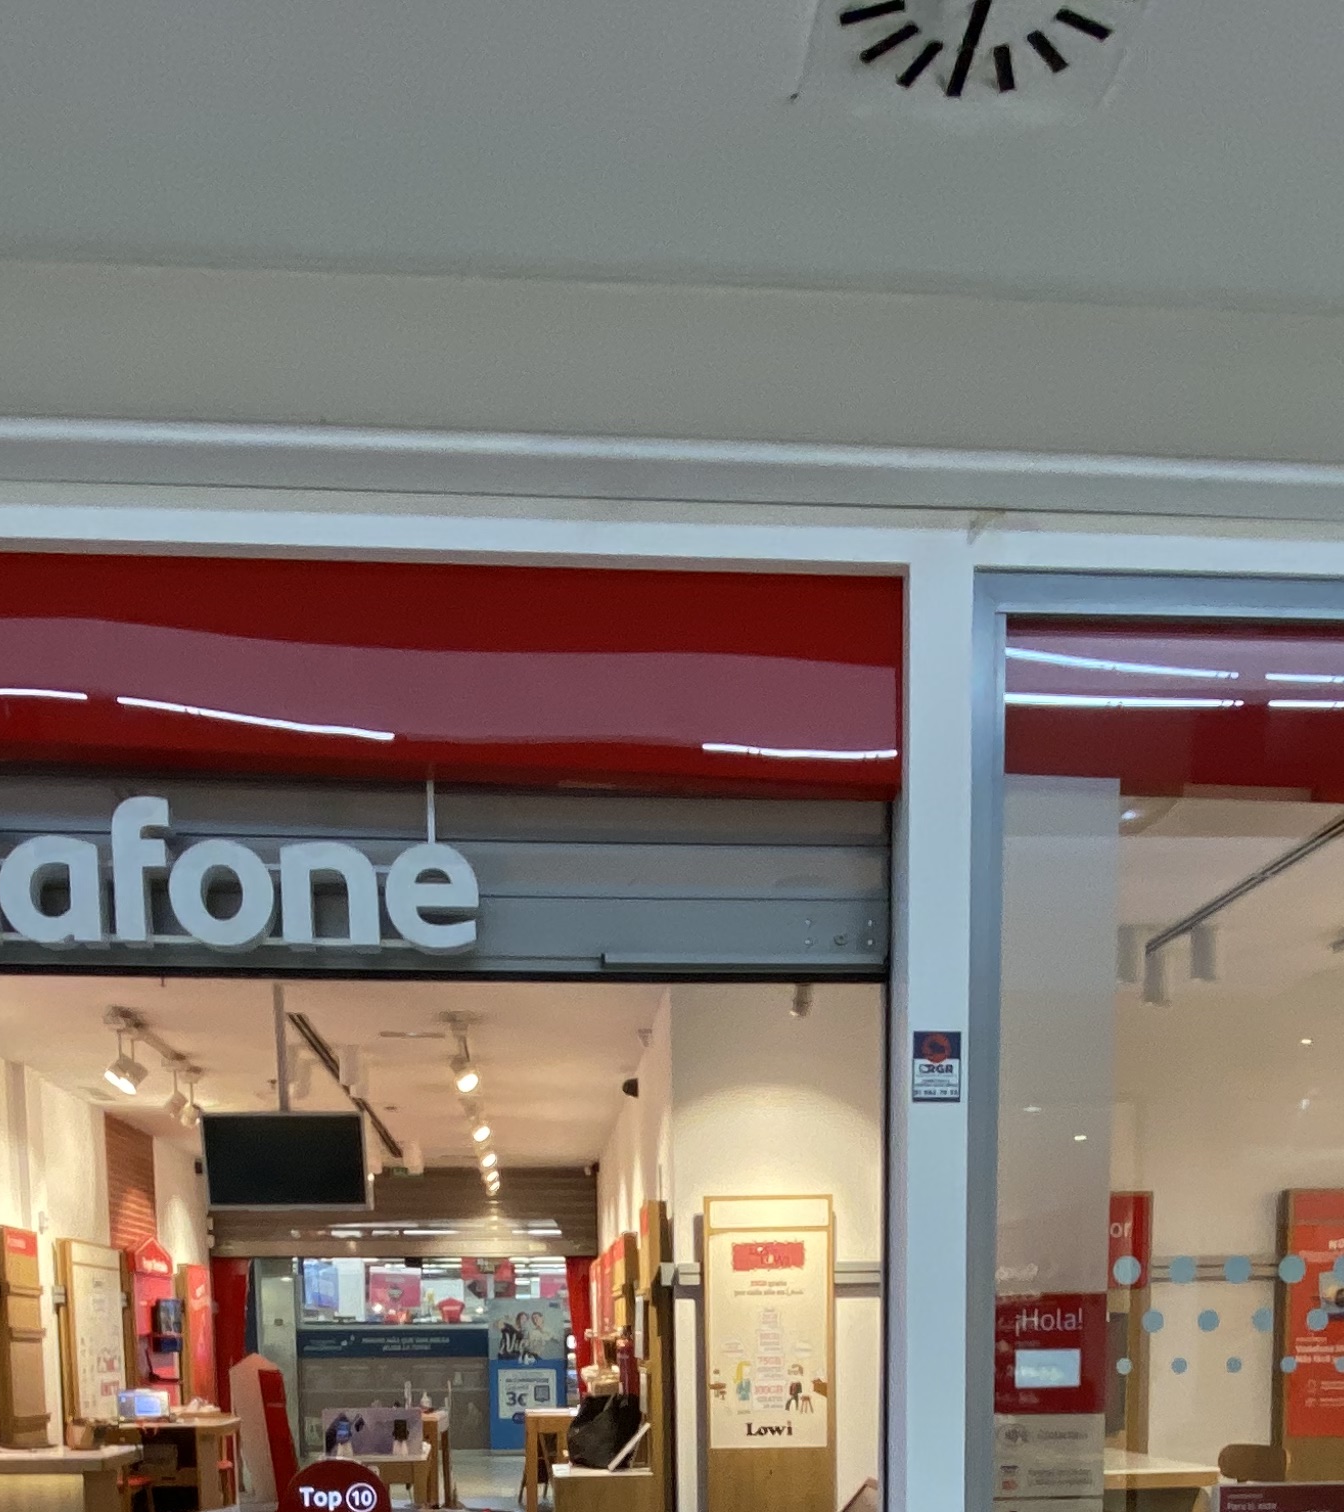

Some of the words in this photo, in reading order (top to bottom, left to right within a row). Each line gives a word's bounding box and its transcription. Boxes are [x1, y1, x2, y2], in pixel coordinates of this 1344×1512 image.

[1015, 1307, 1083, 1337] ¡Hola!
[506, 1391, 528, 1407] 3€
[745, 1420, 793, 1437] Lowi
[299, 1486, 342, 1511] Top
[351, 1489, 373, 1507] 10
